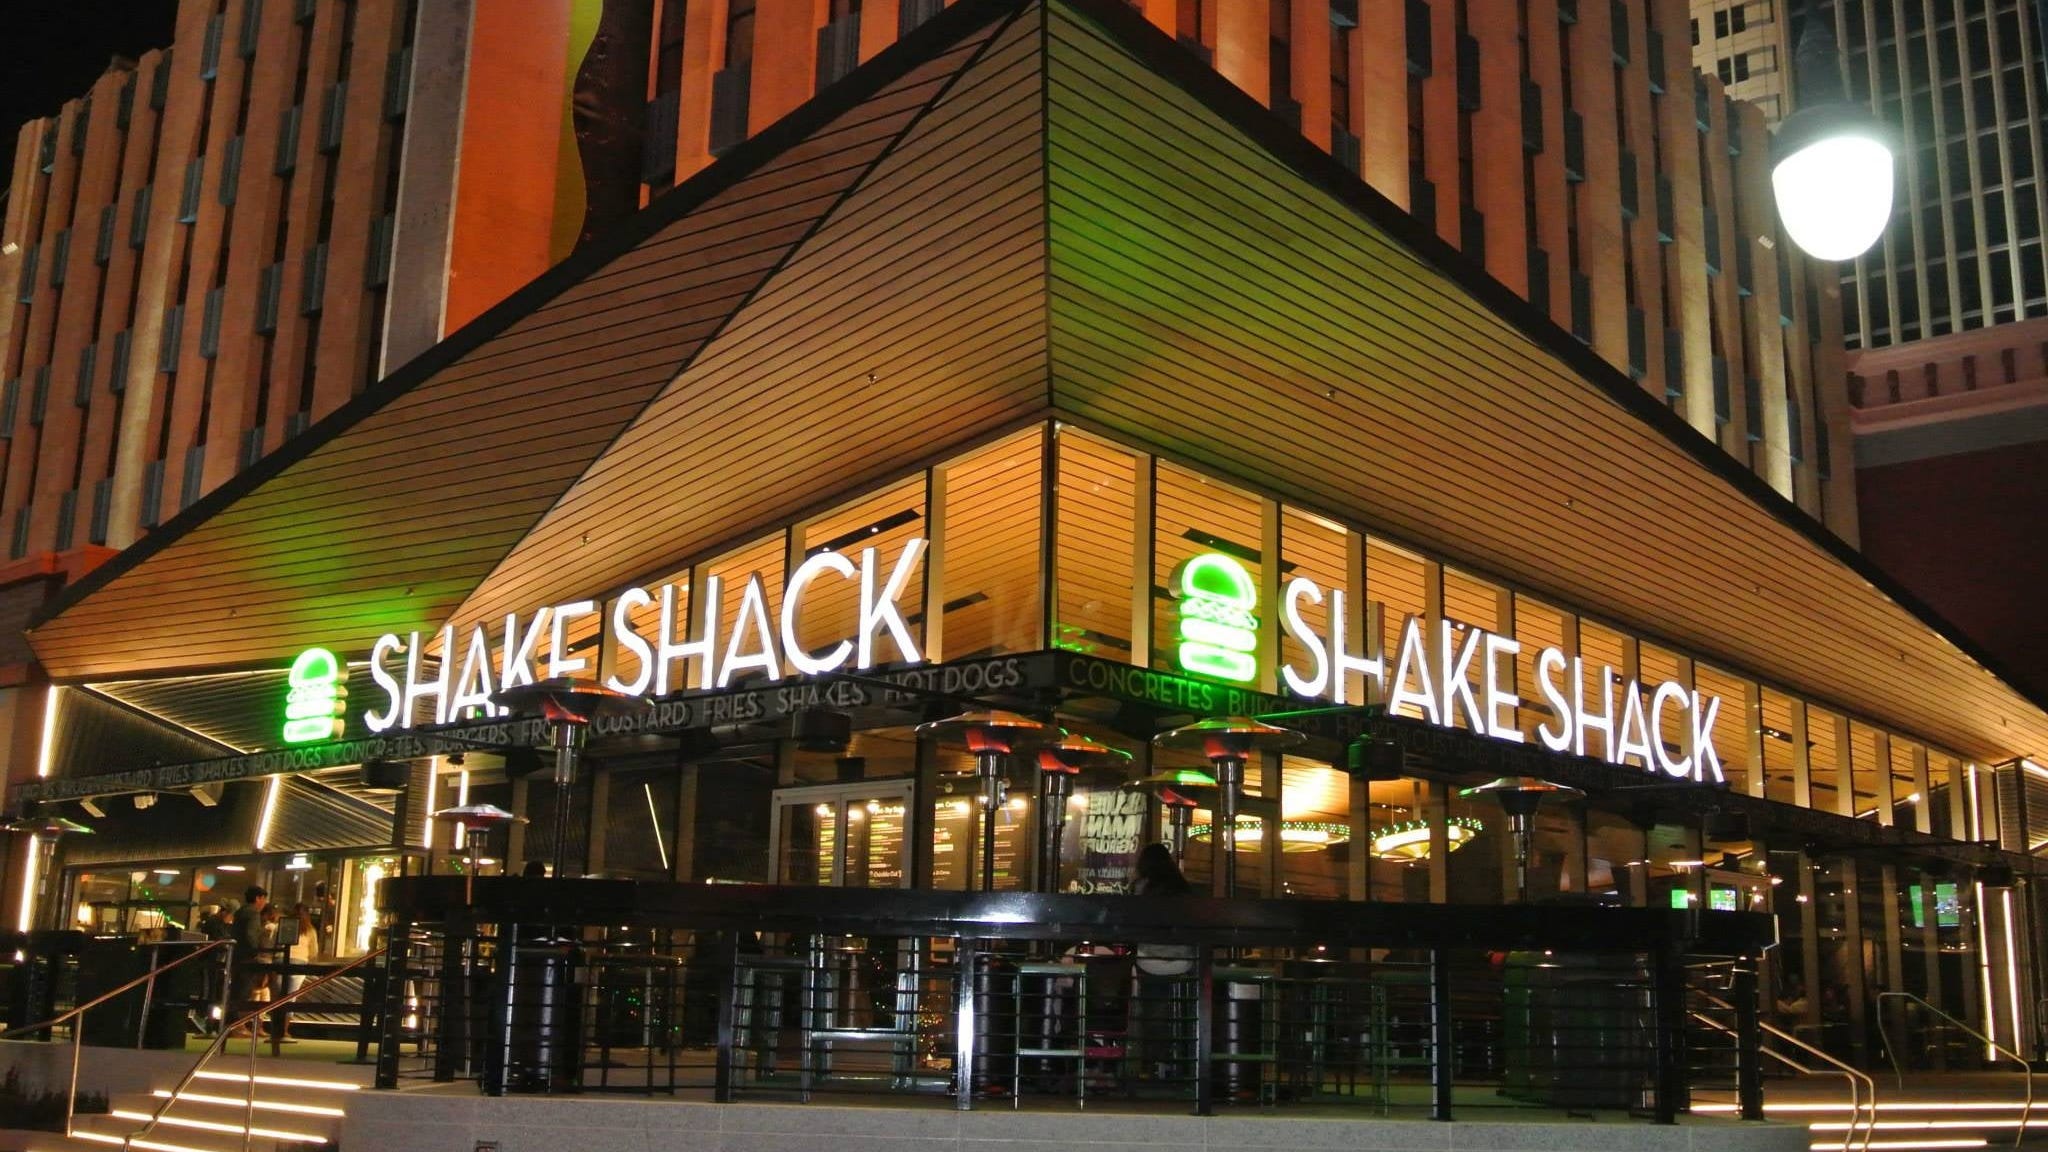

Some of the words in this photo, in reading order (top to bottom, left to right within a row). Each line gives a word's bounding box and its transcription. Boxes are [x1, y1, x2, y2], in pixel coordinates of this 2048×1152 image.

[334, 734, 424, 764] CONCRETES
[702, 691, 759, 722] FRIES
[776, 680, 865, 714] SHAKES
[943, 657, 1019, 694] DOGS
[363, 600, 603, 734] SHAKE
[608, 537, 928, 698] SHACK
[1068, 657, 1214, 712] CONCRETES
[1280, 577, 1524, 744] SHAKE
[1535, 646, 1724, 783] SHACK
